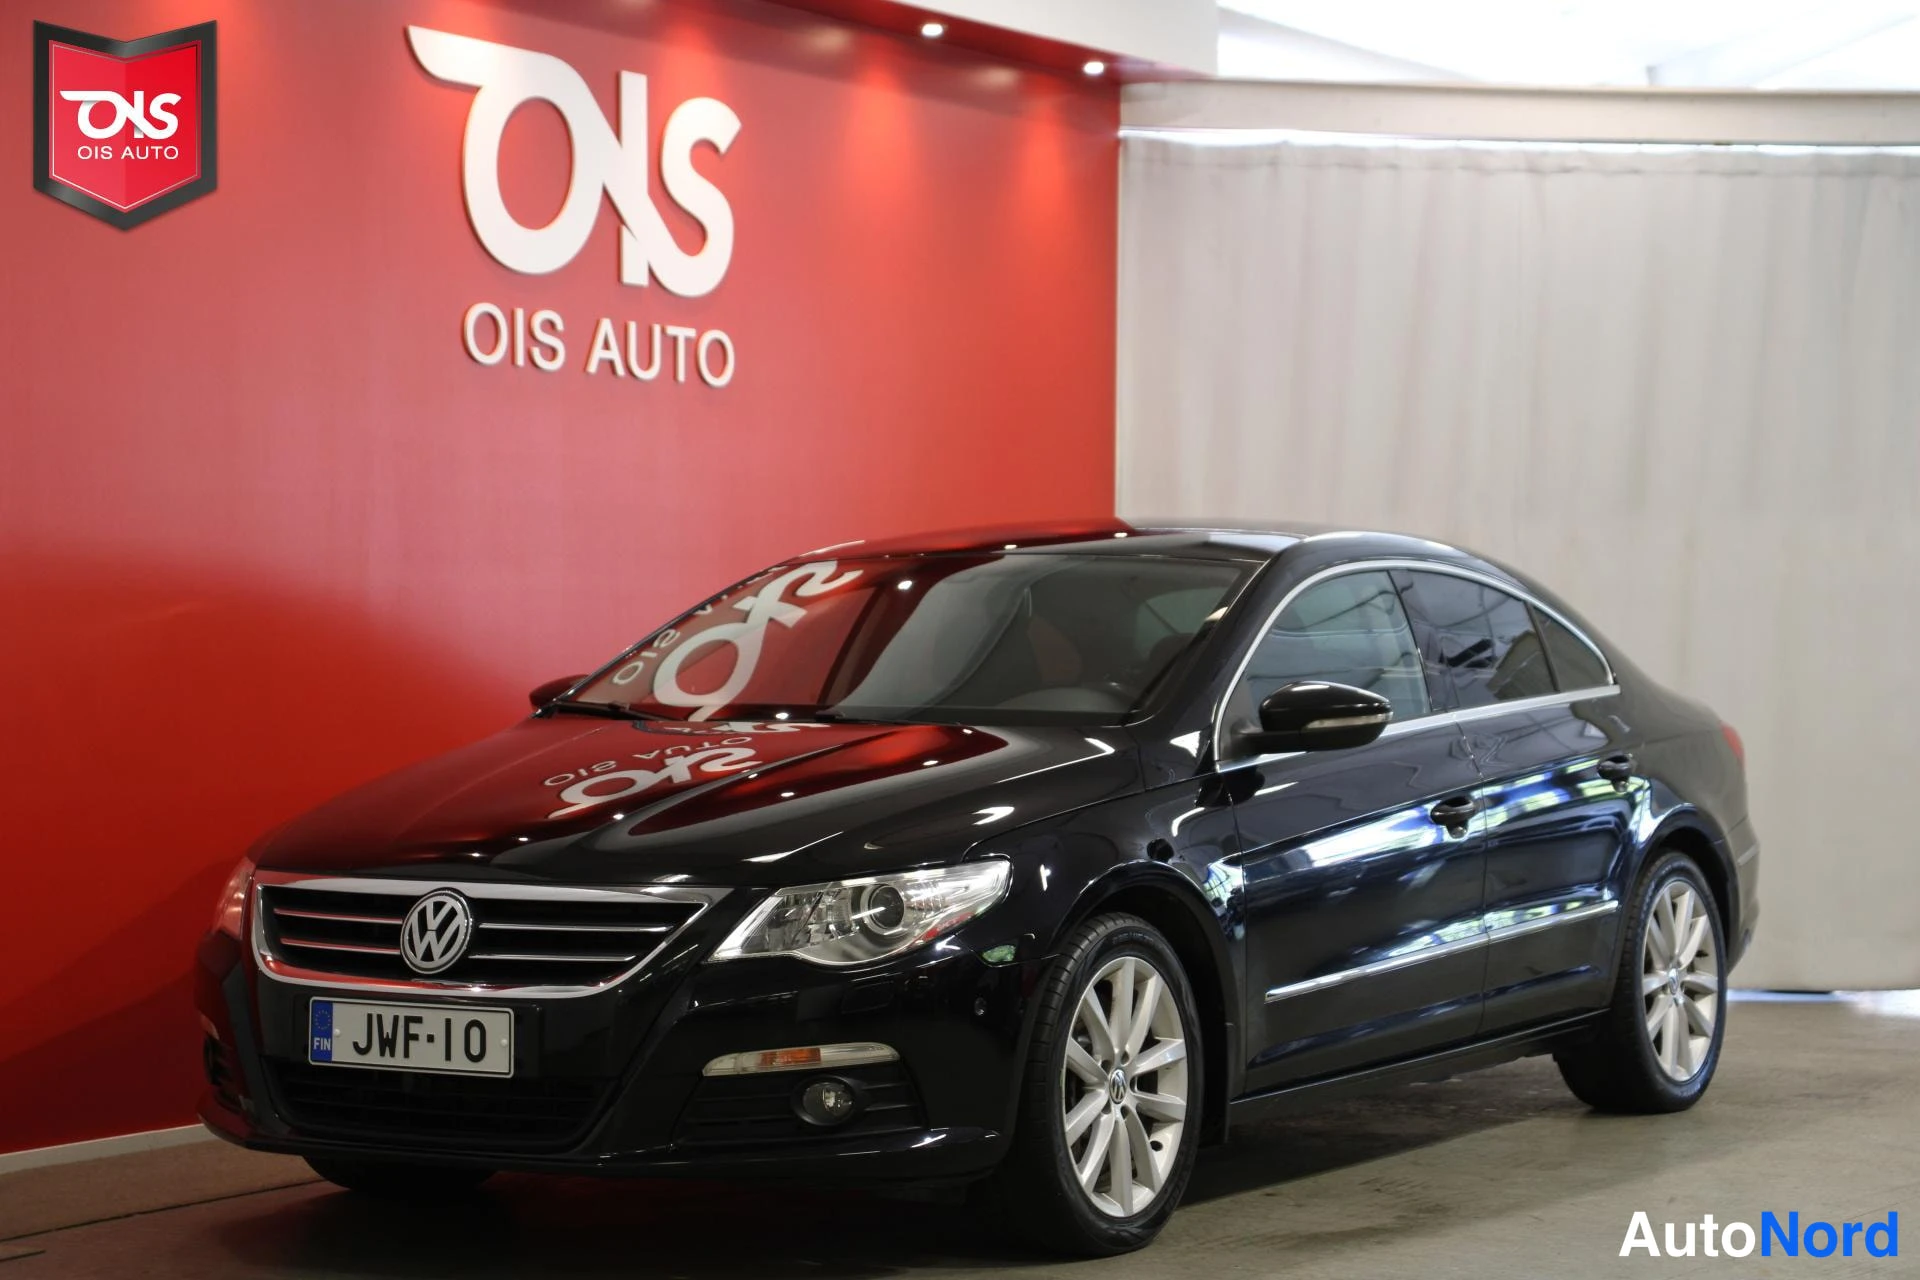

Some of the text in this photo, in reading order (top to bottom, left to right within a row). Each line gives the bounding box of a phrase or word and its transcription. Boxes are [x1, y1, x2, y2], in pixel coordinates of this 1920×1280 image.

[463, 302, 736, 388] OIS AUTO
[402, 889, 471, 973] VW
[313, 1037, 332, 1051] FIN
[352, 1012, 487, 1063] JWF-10
